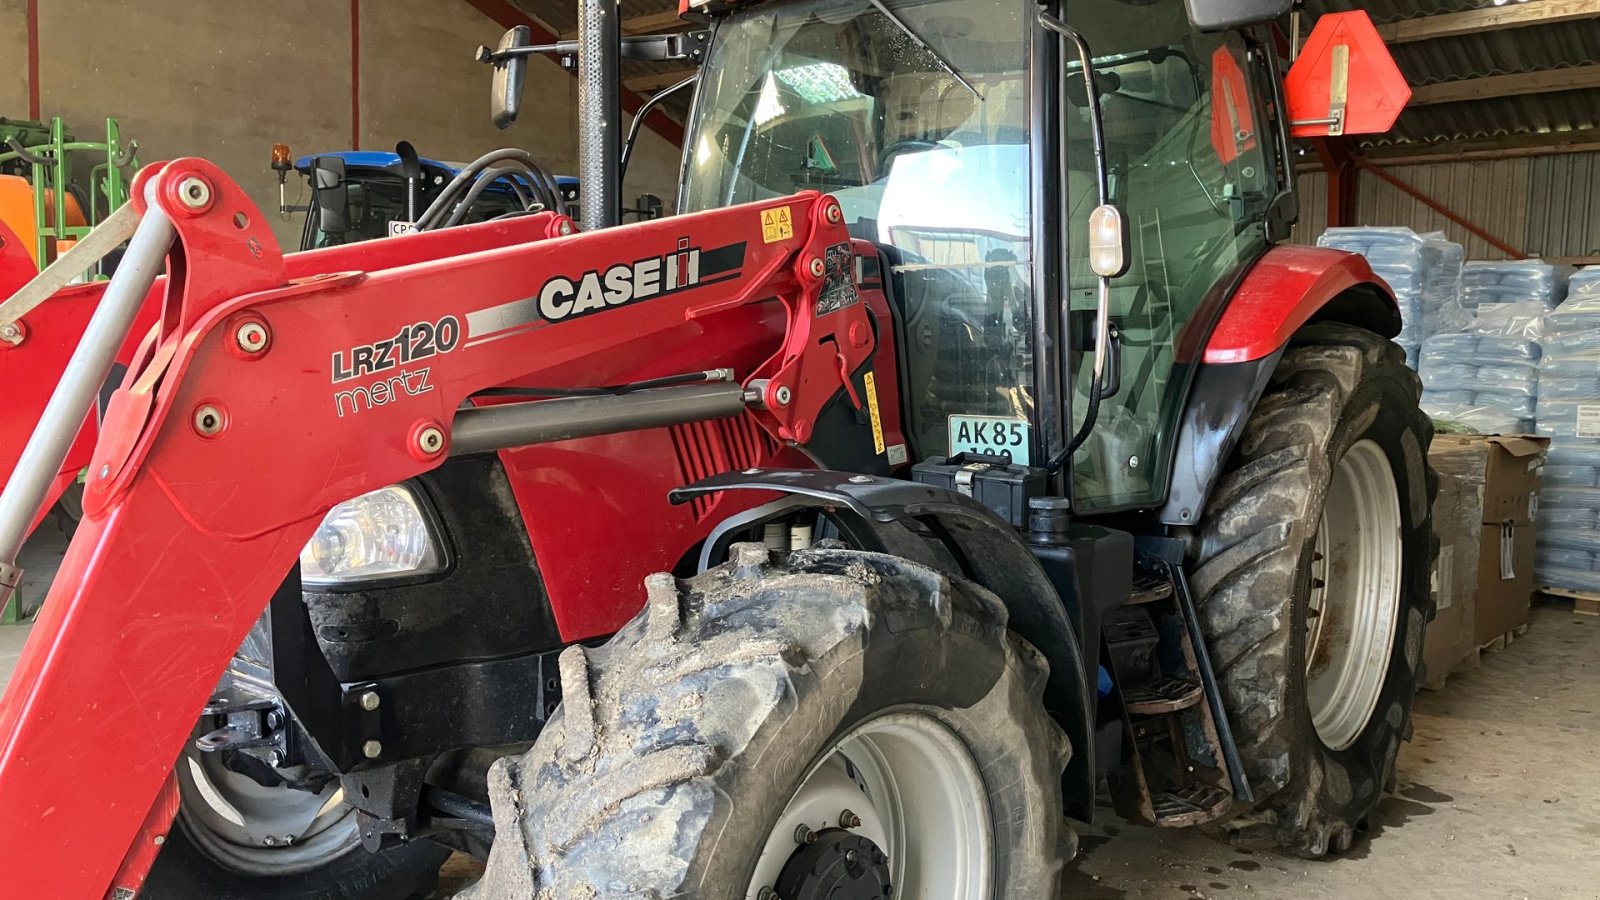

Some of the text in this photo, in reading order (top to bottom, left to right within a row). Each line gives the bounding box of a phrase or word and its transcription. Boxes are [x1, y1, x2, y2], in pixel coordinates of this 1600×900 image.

[539, 257, 661, 320] CASE
[332, 315, 460, 384] LRZ120
[334, 367, 434, 417] mertz
